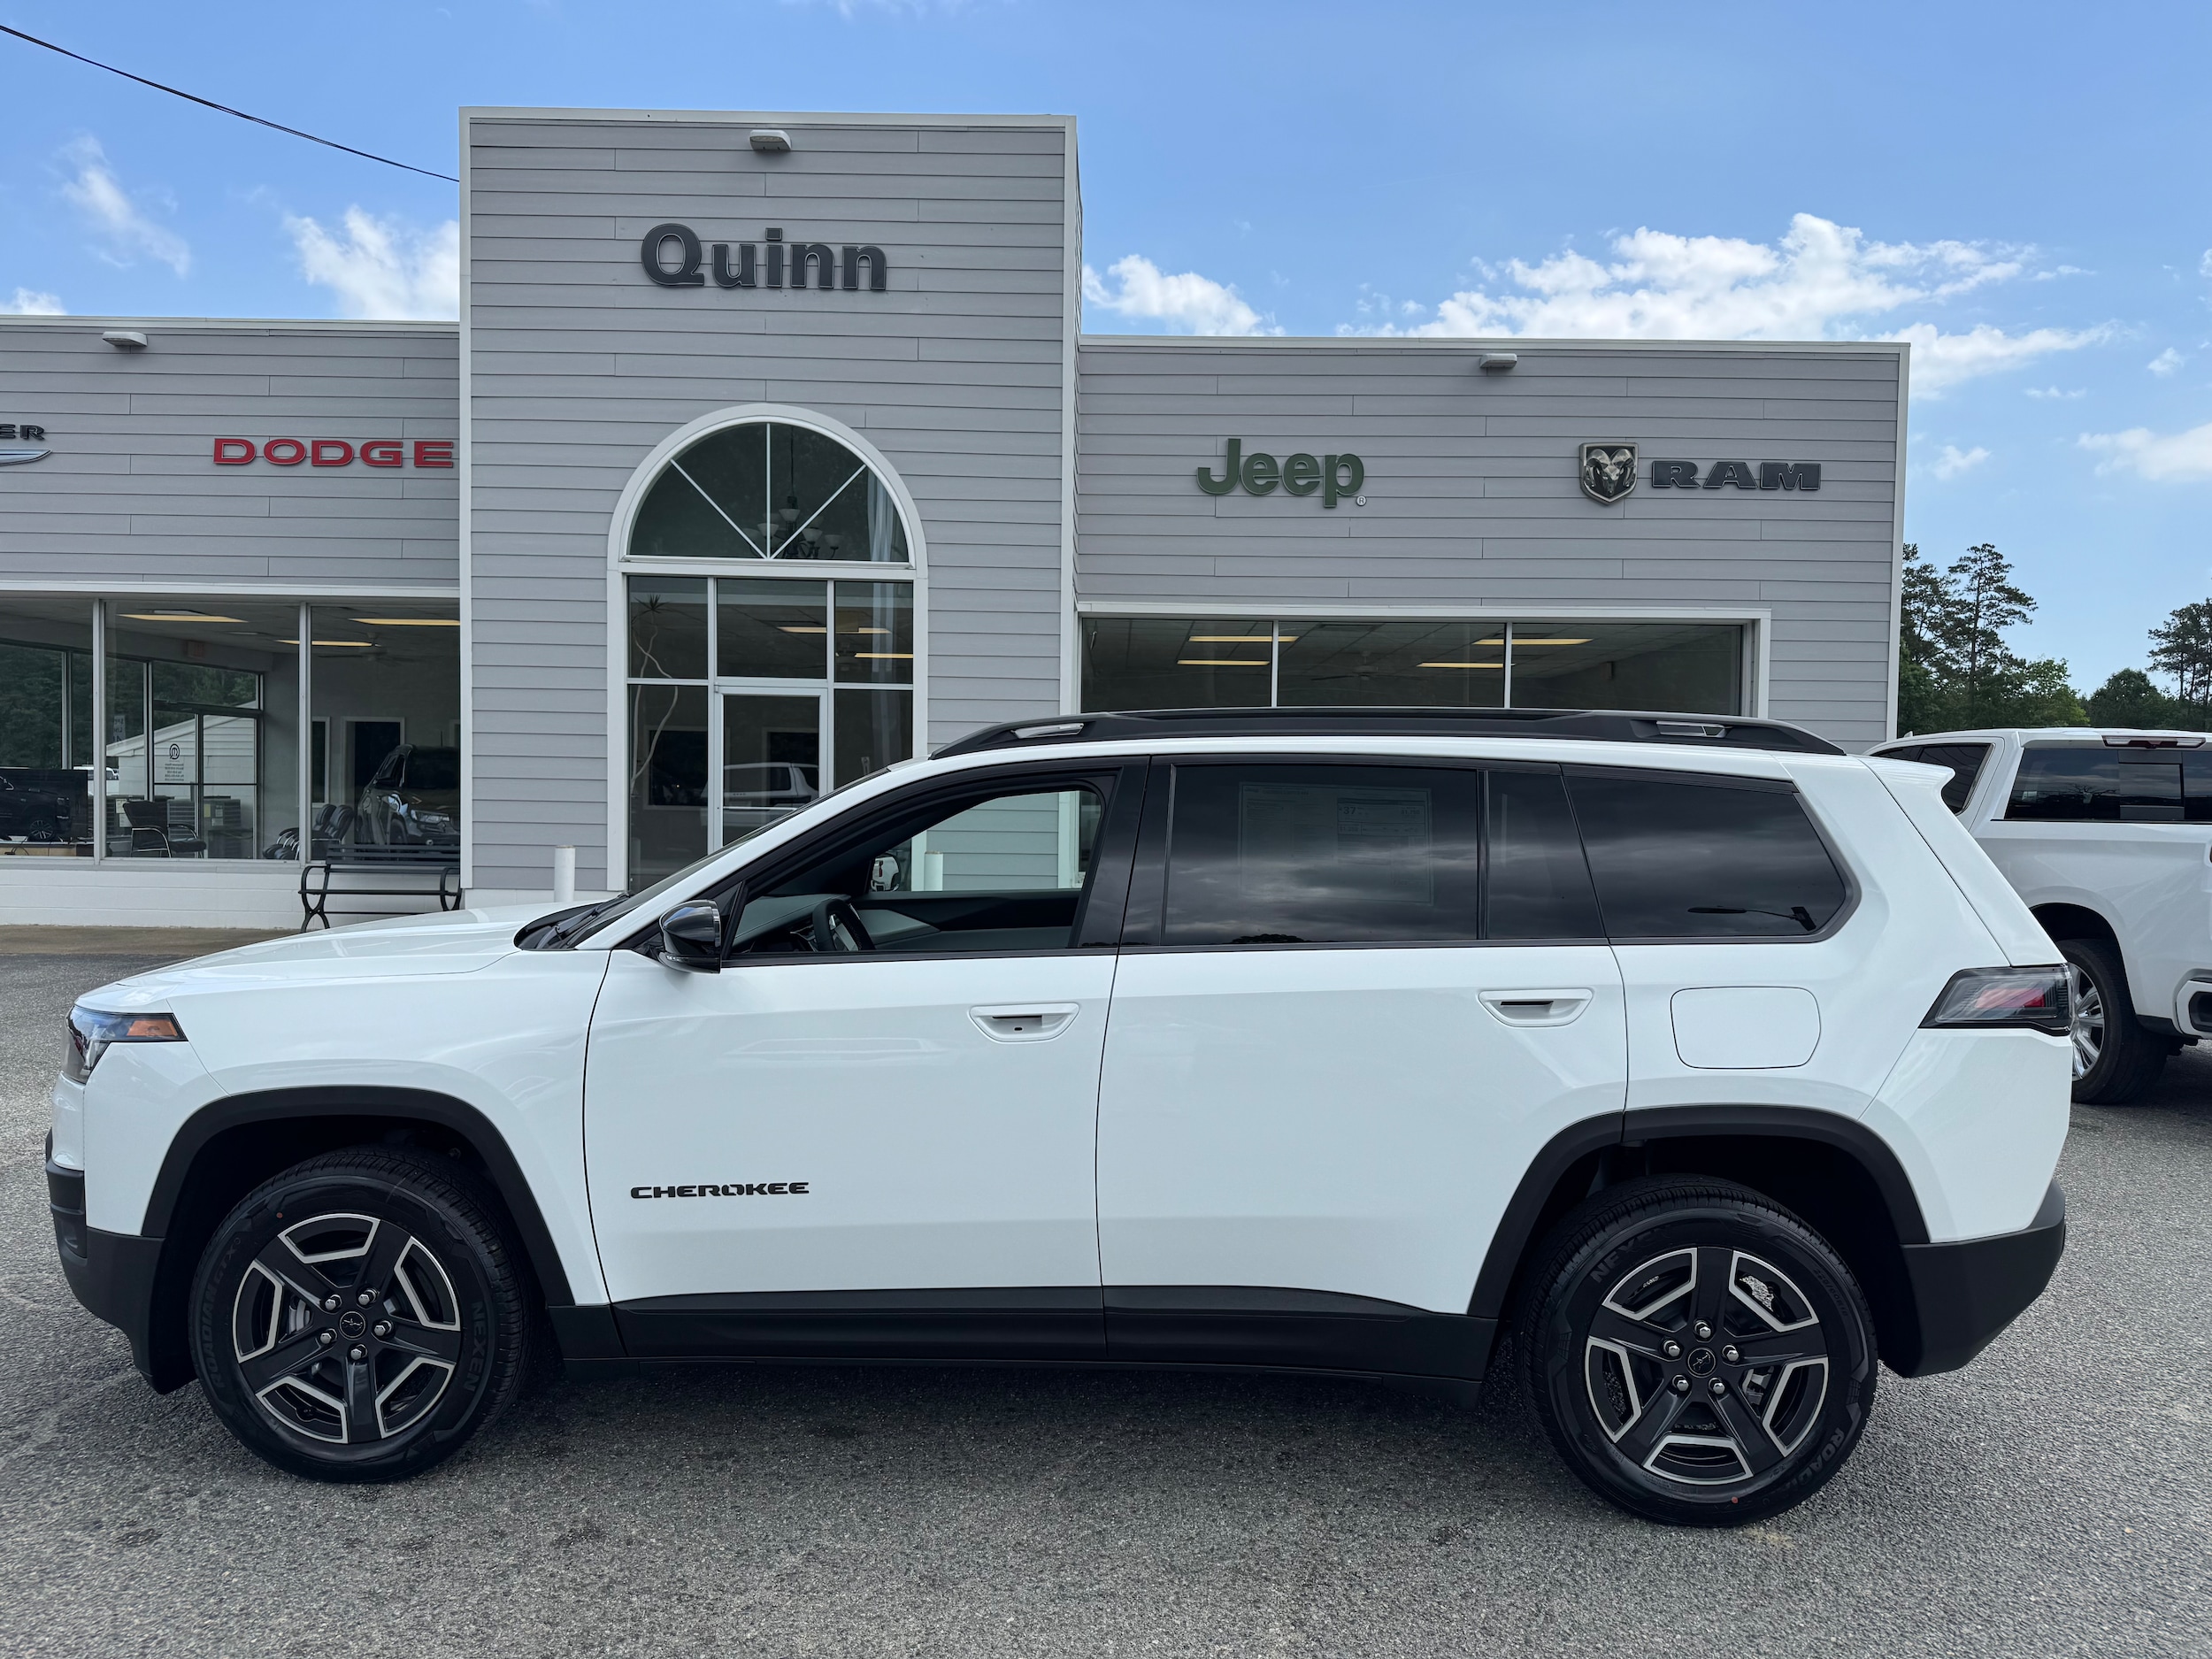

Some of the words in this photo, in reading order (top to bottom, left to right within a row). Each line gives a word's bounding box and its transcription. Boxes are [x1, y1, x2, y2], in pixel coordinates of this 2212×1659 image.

[641, 223, 887, 290] Quinn
[213, 437, 455, 468] DODGE
[1196, 437, 1365, 509] Jeep
[1651, 460, 1823, 490] RAM
[630, 1181, 810, 1199] CHEROKEE
[201, 1284, 226, 1388] ROADIAN
[463, 1300, 487, 1392] NEXEN
